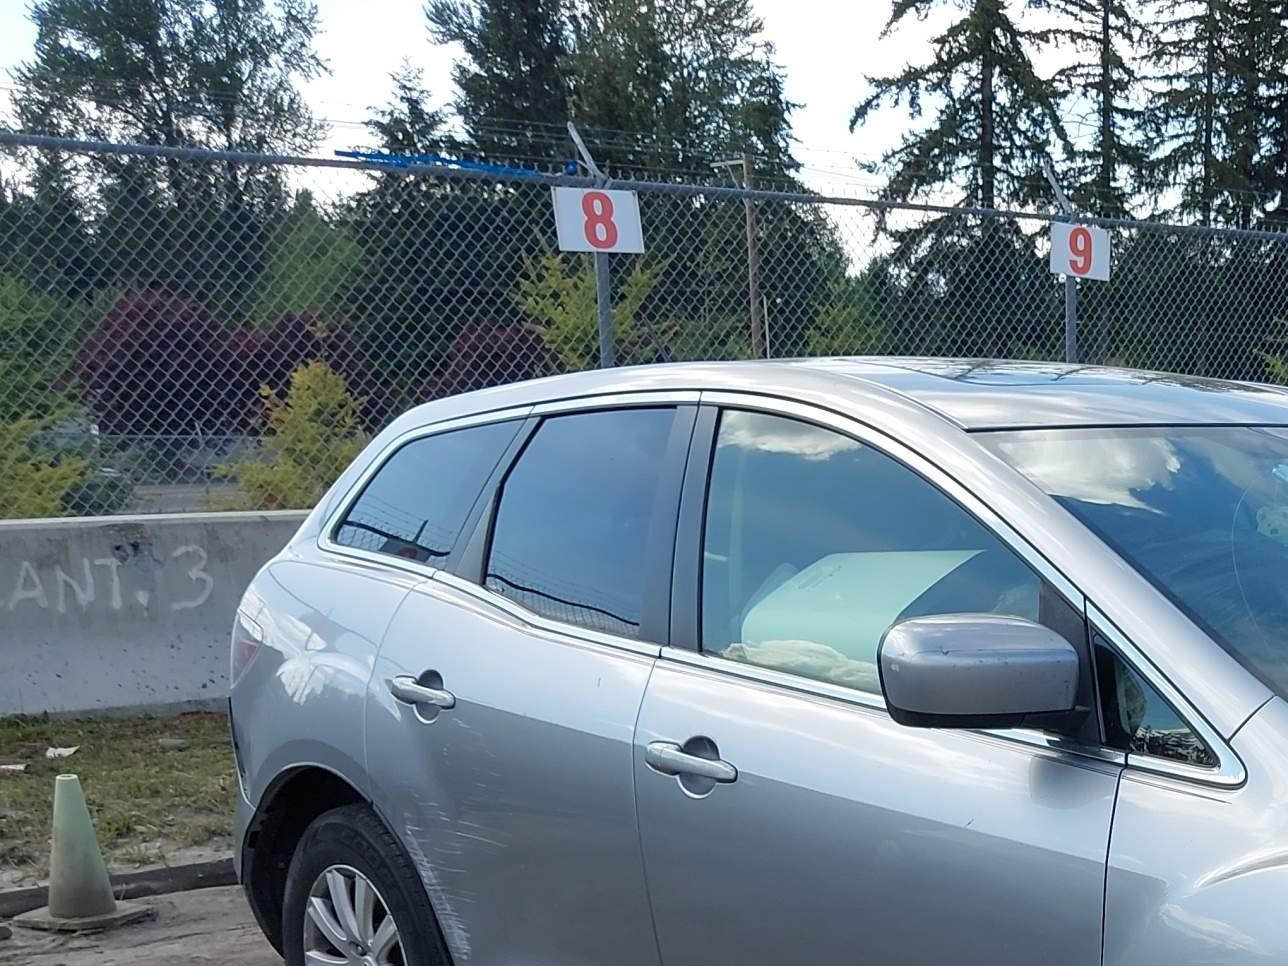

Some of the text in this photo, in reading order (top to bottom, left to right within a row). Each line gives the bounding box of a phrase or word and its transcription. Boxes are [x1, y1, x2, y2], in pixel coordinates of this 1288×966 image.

[580, 190, 619, 251] 8
[1067, 225, 1094, 277] 9
[171, 544, 214, 611] 3
